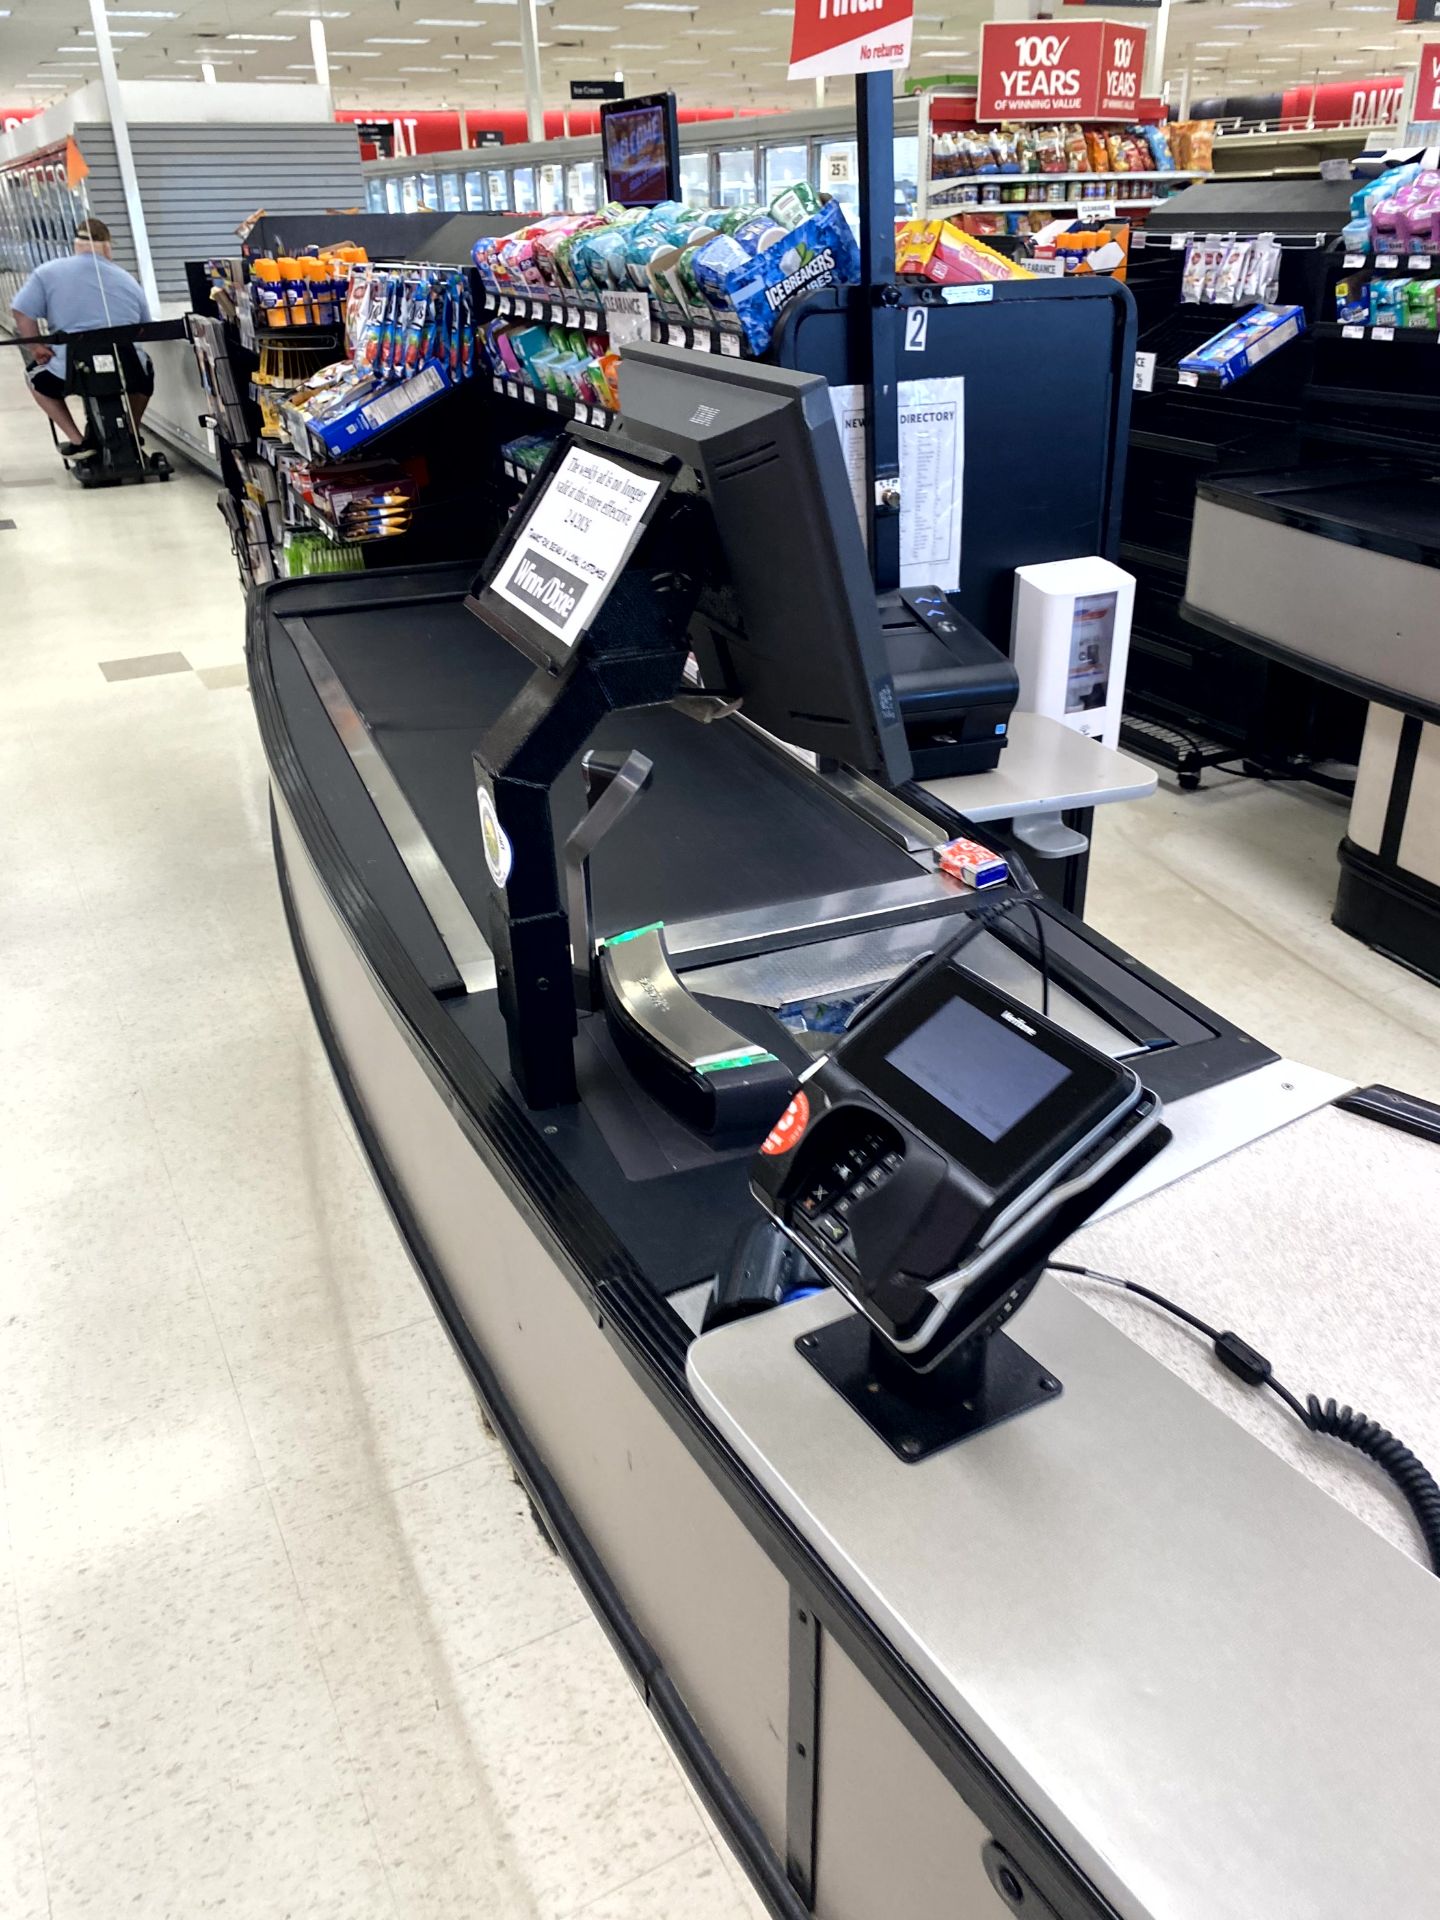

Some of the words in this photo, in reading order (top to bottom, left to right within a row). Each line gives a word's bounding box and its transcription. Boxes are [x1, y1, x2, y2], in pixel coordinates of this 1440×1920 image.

[860, 45, 872, 60] No
[873, 43, 904, 58] returns
[1015, 35, 1064, 67] 100
[1113, 37, 1132, 68] 100
[583, 86, 604, 95] Cream
[1000, 69, 1081, 97] YEARS
[1106, 70, 1137, 98] YEARS
[994, 100, 1007, 111] OF
[1008, 98, 1051, 110] WINNING
[1052, 97, 1082, 109] VALUE
[765, 285, 786, 311] ICE
[783, 248, 835, 295] BREAKERS
[604, 296, 641, 315] CLEARANCE
[910, 310, 926, 348] 2
[900, 411, 954, 424] DIRECTORY
[567, 457, 581, 474] The
[579, 465, 599, 484] weekly
[620, 479, 647, 504] longer
[556, 480, 574, 495] valid
[584, 495, 602, 512] store
[600, 500, 633, 526] effective
